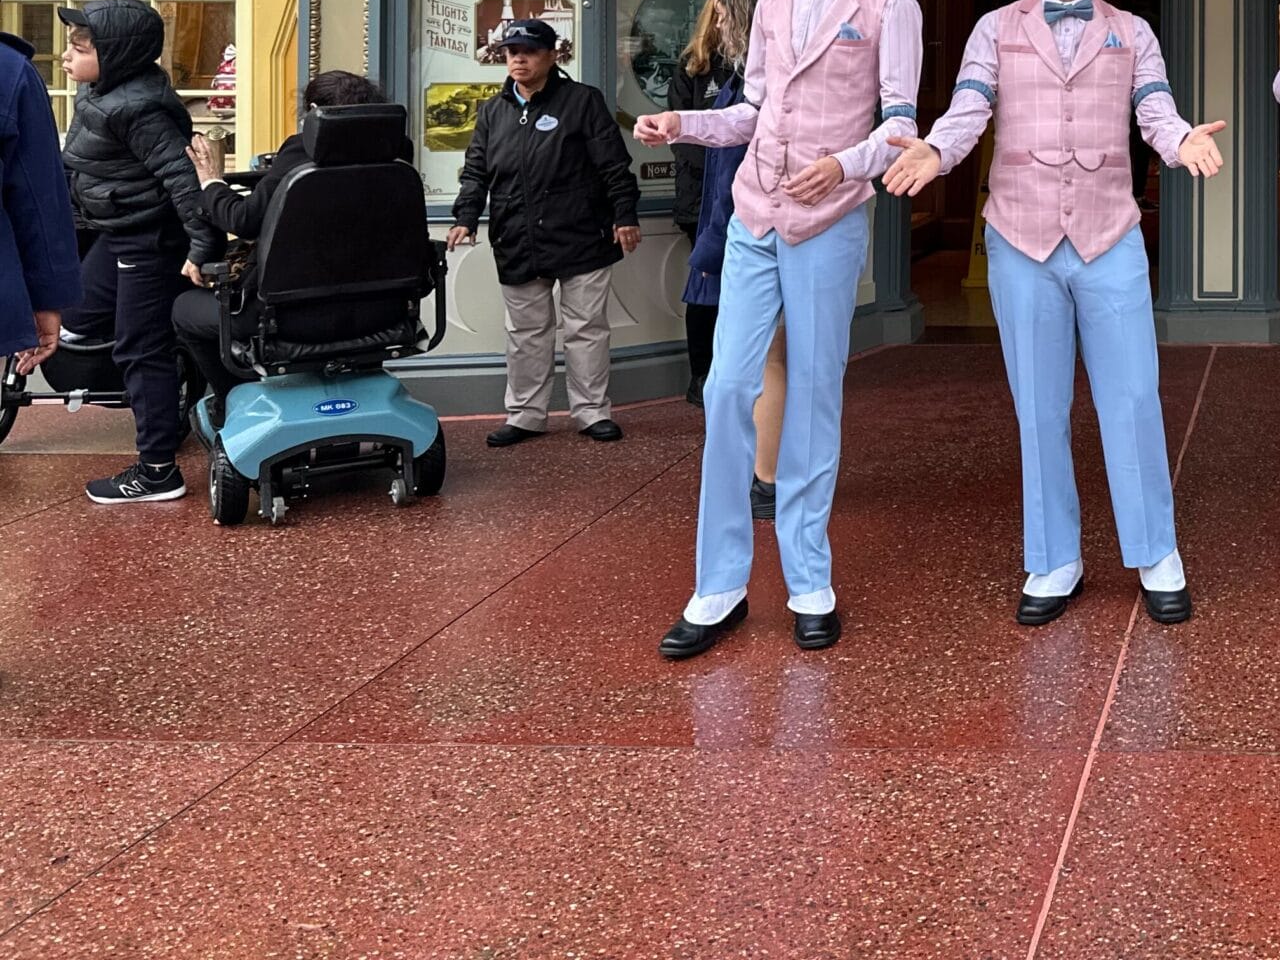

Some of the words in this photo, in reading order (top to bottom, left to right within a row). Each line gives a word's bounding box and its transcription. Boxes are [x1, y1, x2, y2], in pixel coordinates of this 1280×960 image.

[442, 18, 457, 35] OF
[426, 29, 469, 53] FANTASY
[647, 164, 668, 178] NOW
